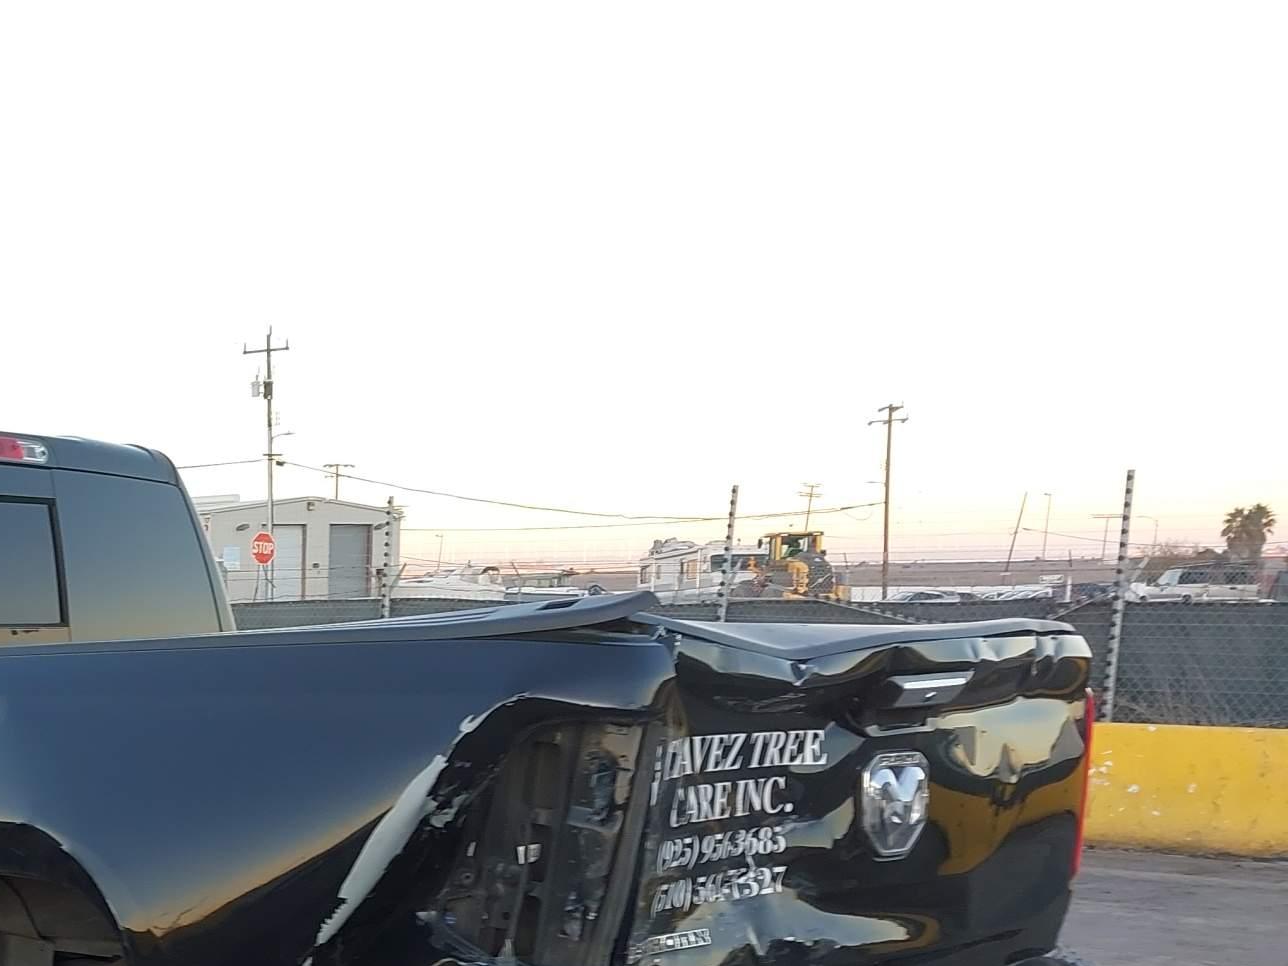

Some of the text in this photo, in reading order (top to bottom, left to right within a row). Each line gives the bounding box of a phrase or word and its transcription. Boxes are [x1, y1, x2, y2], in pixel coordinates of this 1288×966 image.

[252, 541, 274, 554] STOP
[748, 730, 828, 768] TREE
[670, 776, 794, 827] CARE INC.
